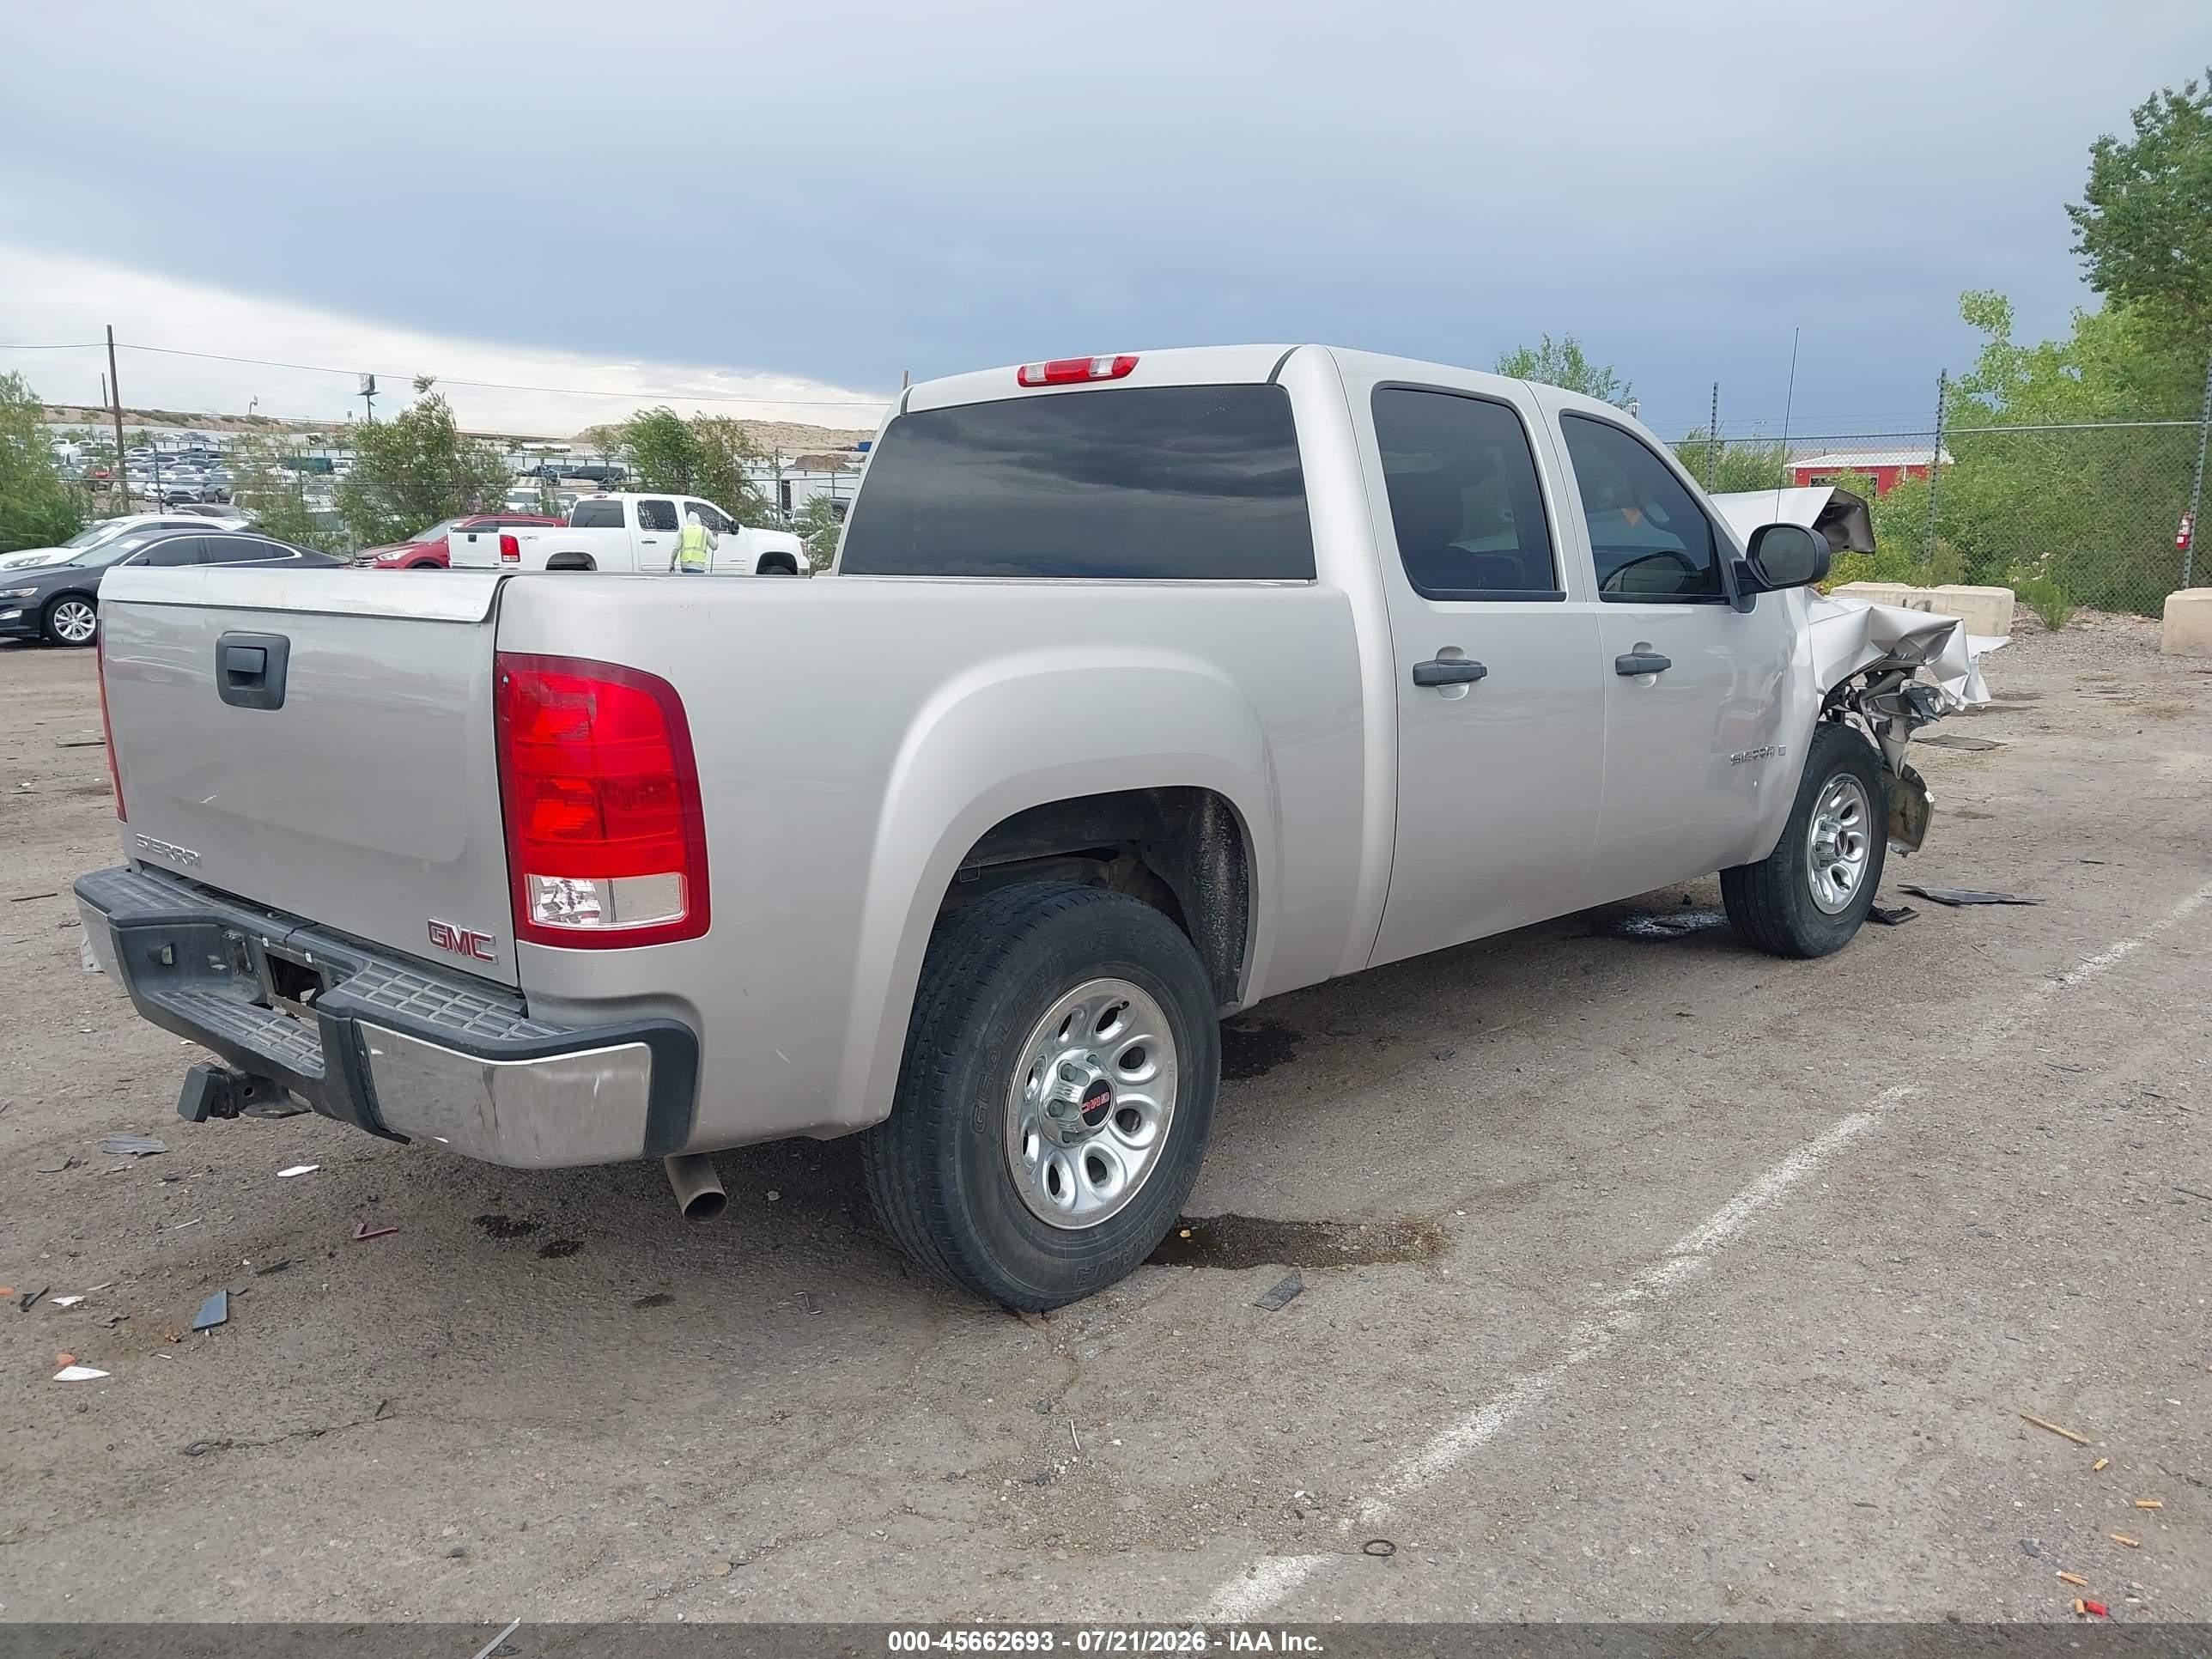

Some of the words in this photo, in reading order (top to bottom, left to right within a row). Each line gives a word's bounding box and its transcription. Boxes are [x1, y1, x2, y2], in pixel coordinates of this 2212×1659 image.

[1730, 745, 1776, 767] SIERRA
[135, 832, 201, 869] SIERRA
[427, 918, 500, 967] GMC
[1080, 1091, 1111, 1116] GMC
